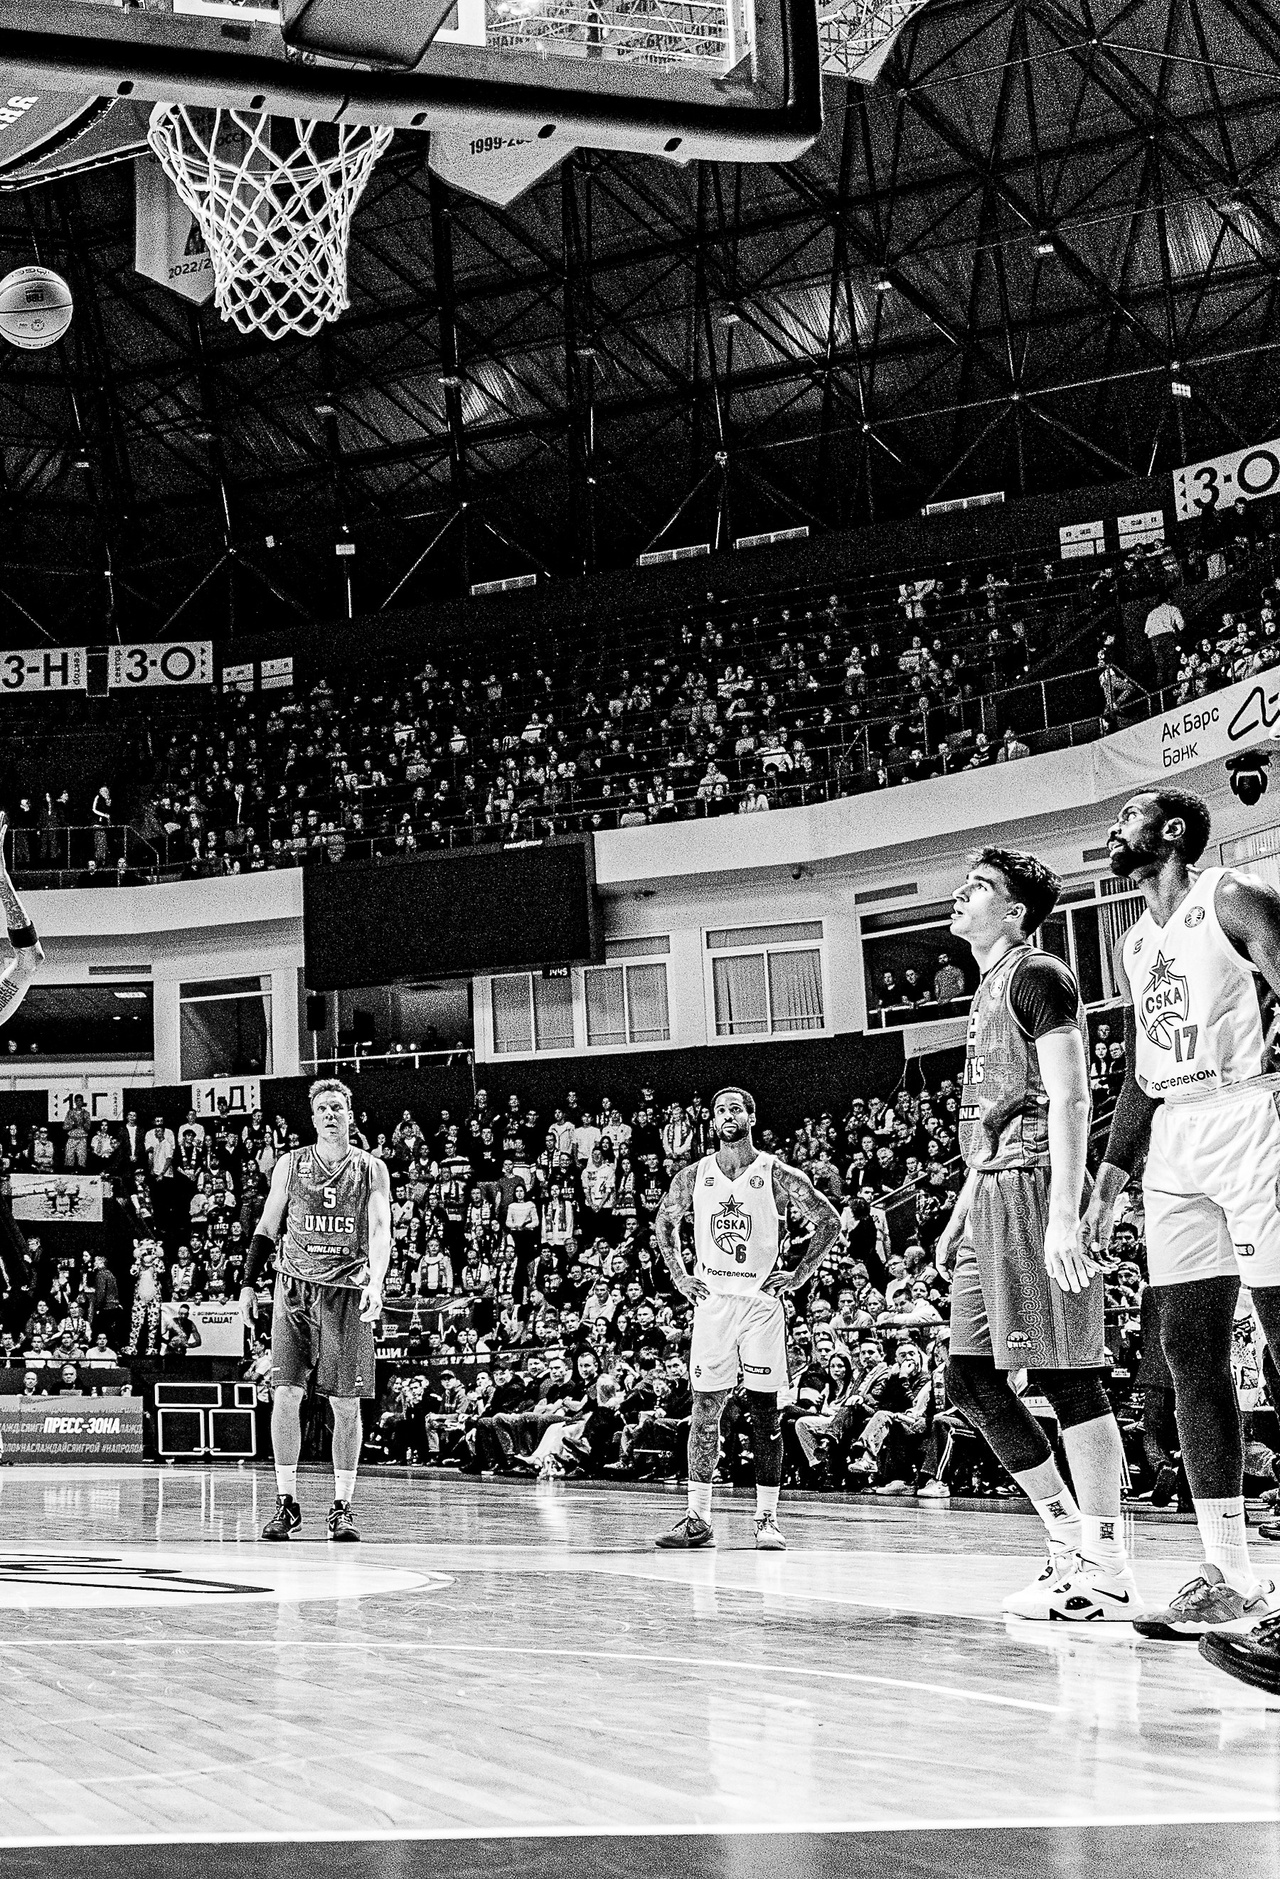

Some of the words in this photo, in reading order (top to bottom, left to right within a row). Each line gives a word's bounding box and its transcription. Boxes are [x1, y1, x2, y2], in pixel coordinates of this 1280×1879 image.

[168, 258, 212, 280] 2022/2
[1161, 722, 1181, 742] Ак
[1183, 707, 1220, 734] Барс
[1162, 742, 1199, 768] Банк
[1145, 987, 1183, 1013] CSKA
[1174, 1024, 1198, 1062] 17
[323, 1187, 336, 1208] 5
[305, 1215, 355, 1233] UNICS
[716, 1219, 747, 1231] CSKA
[306, 1244, 342, 1255] WINLINE
[734, 1243, 747, 1263] 6
[201, 1316, 232, 1324] САША!
[1007, 1341, 1033, 1349] UNICS
[43, 1417, 121, 1434] ПРЕСС-ЗОНА
